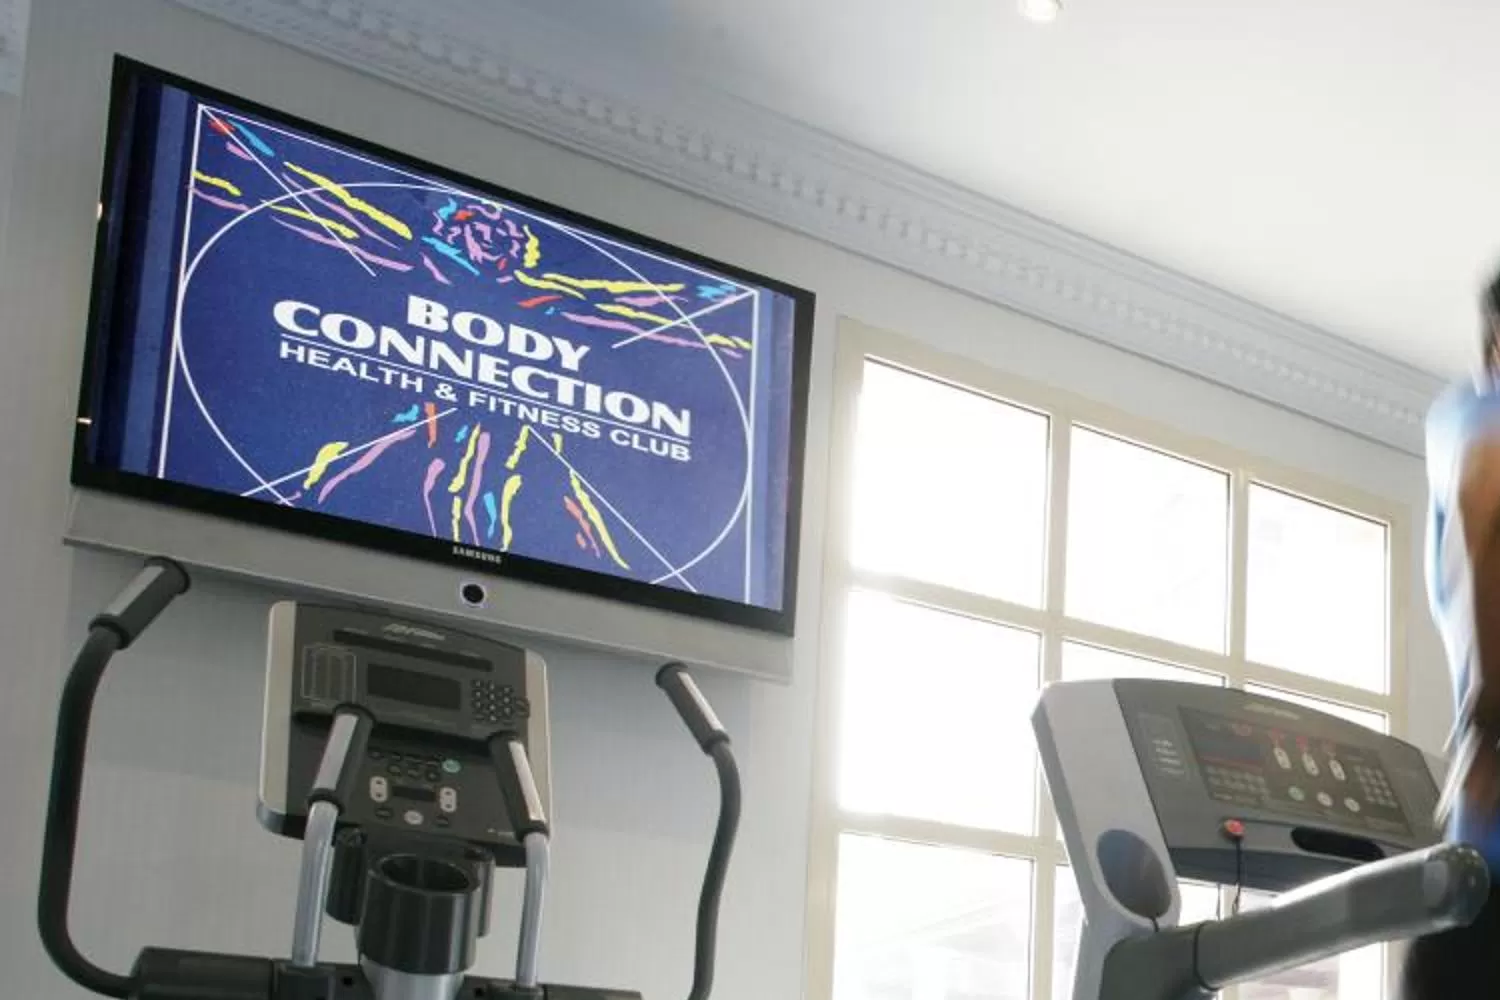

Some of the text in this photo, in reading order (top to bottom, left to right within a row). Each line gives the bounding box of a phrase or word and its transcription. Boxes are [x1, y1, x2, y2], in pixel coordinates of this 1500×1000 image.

[273, 300, 691, 438] CONNECTION
[407, 294, 591, 372] BODY
[280, 341, 692, 462] HEALTH & FITNESS CLUB
